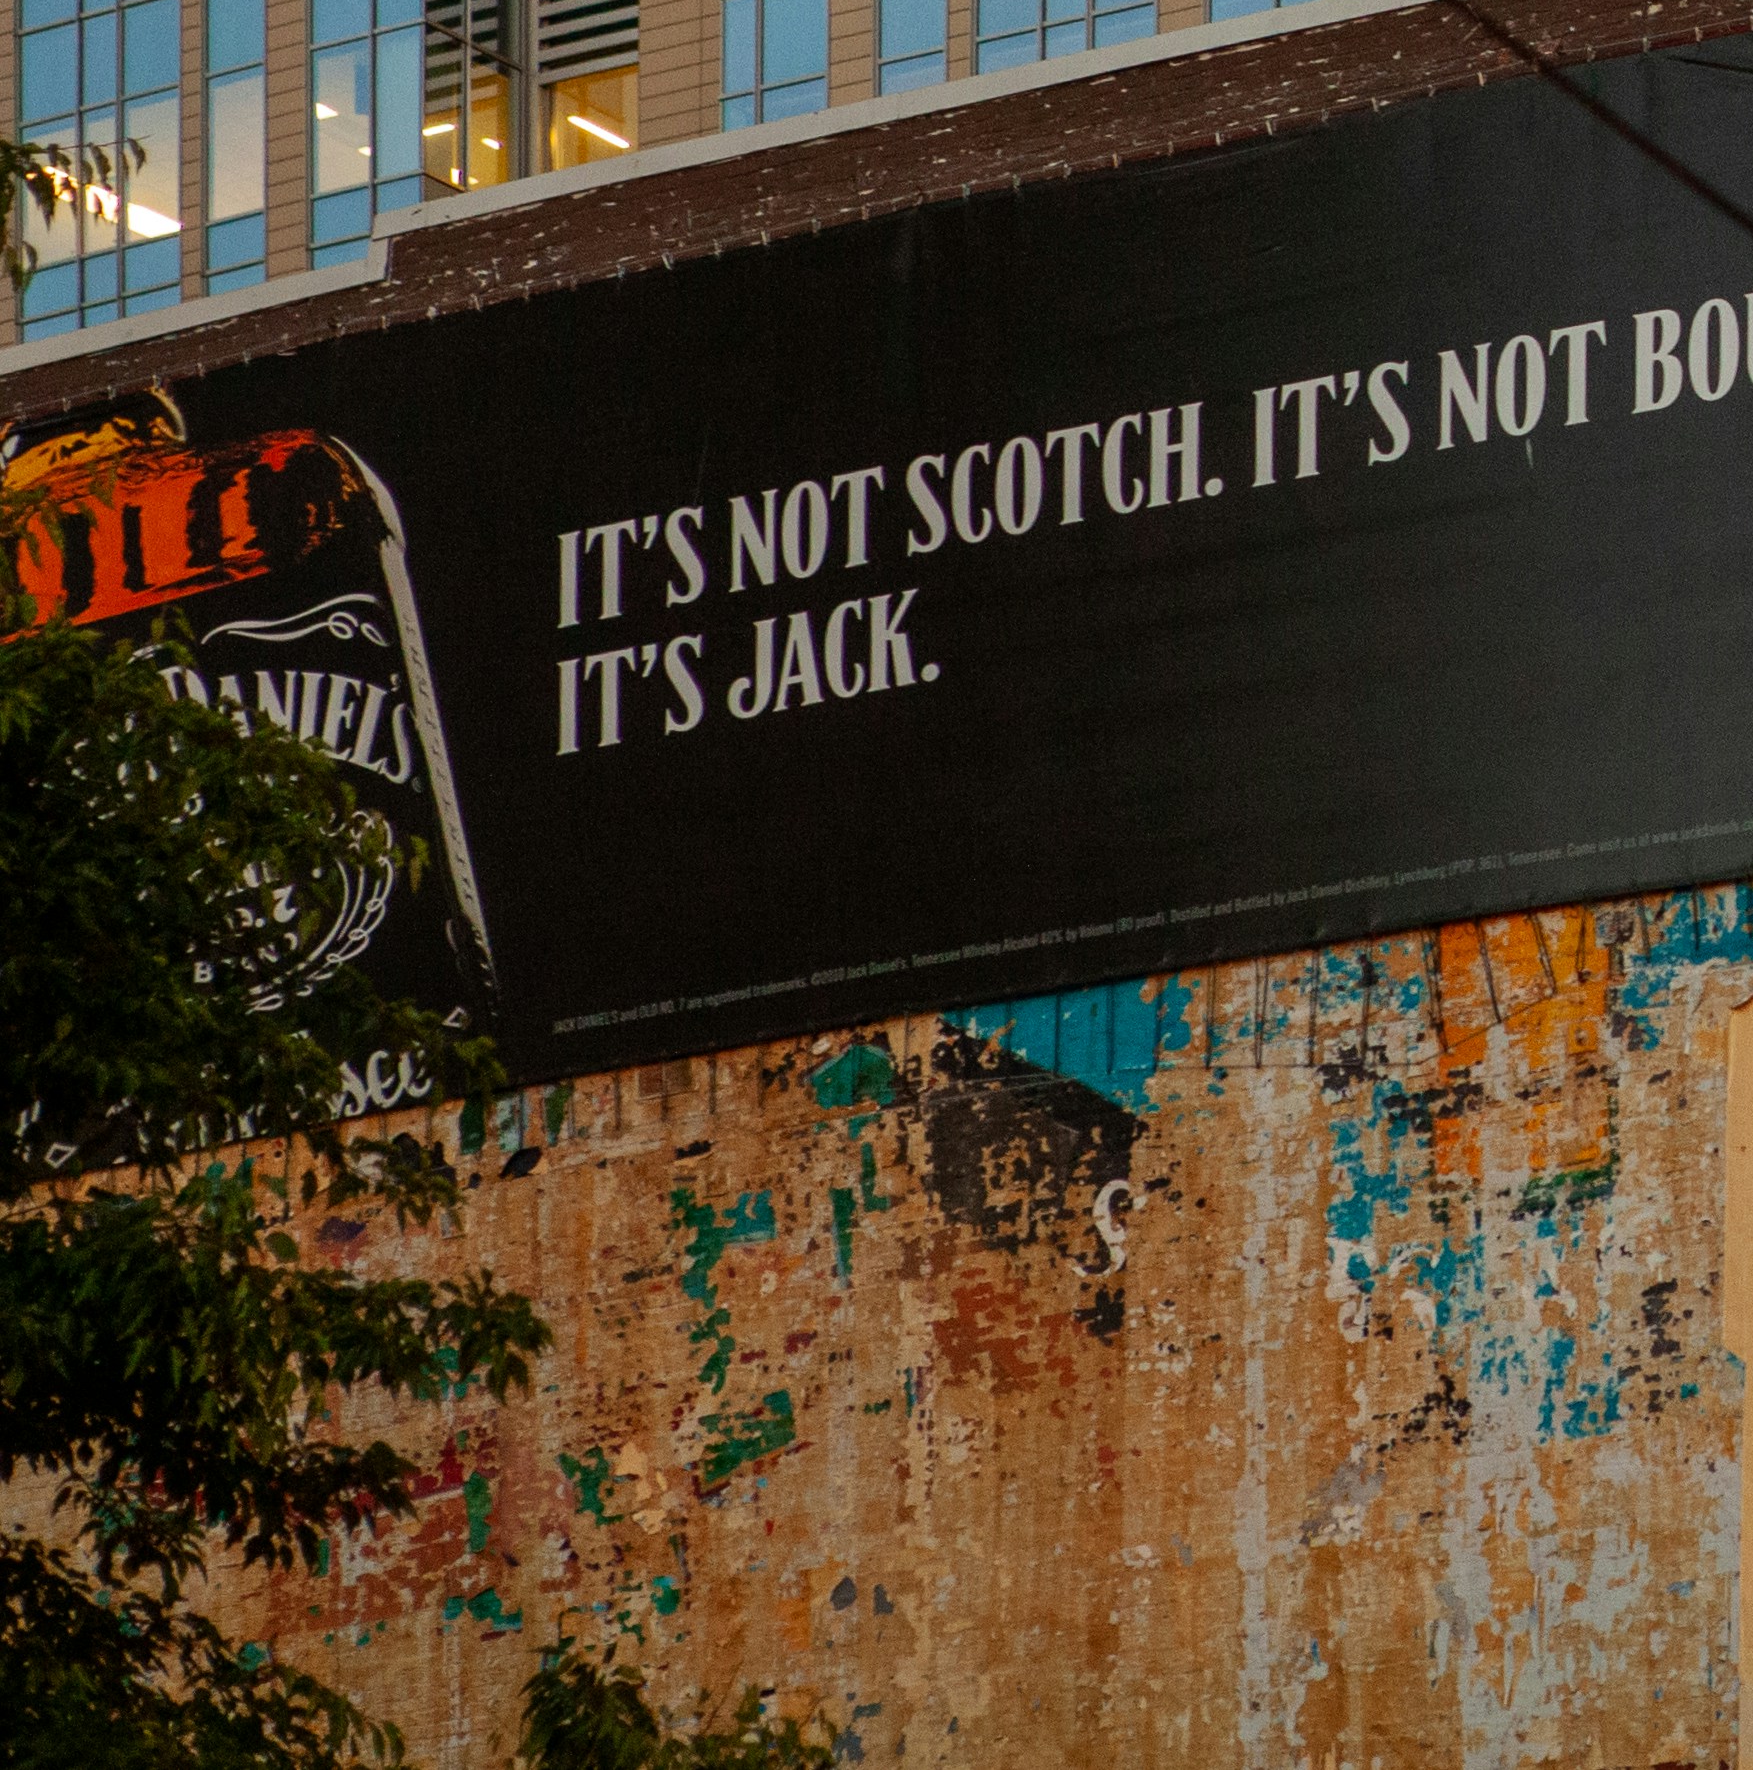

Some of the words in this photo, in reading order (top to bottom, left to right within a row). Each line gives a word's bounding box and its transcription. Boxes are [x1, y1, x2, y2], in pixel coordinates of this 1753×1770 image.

[558, 507, 705, 628] IT'S
[729, 466, 884, 592] NOT
[907, 402, 1223, 556] SCOTCH.
[1252, 361, 1411, 487] IT'S
[1436, 320, 1607, 450] NOT
[556, 634, 704, 756] IT'S
[727, 588, 940, 720] JACK.
